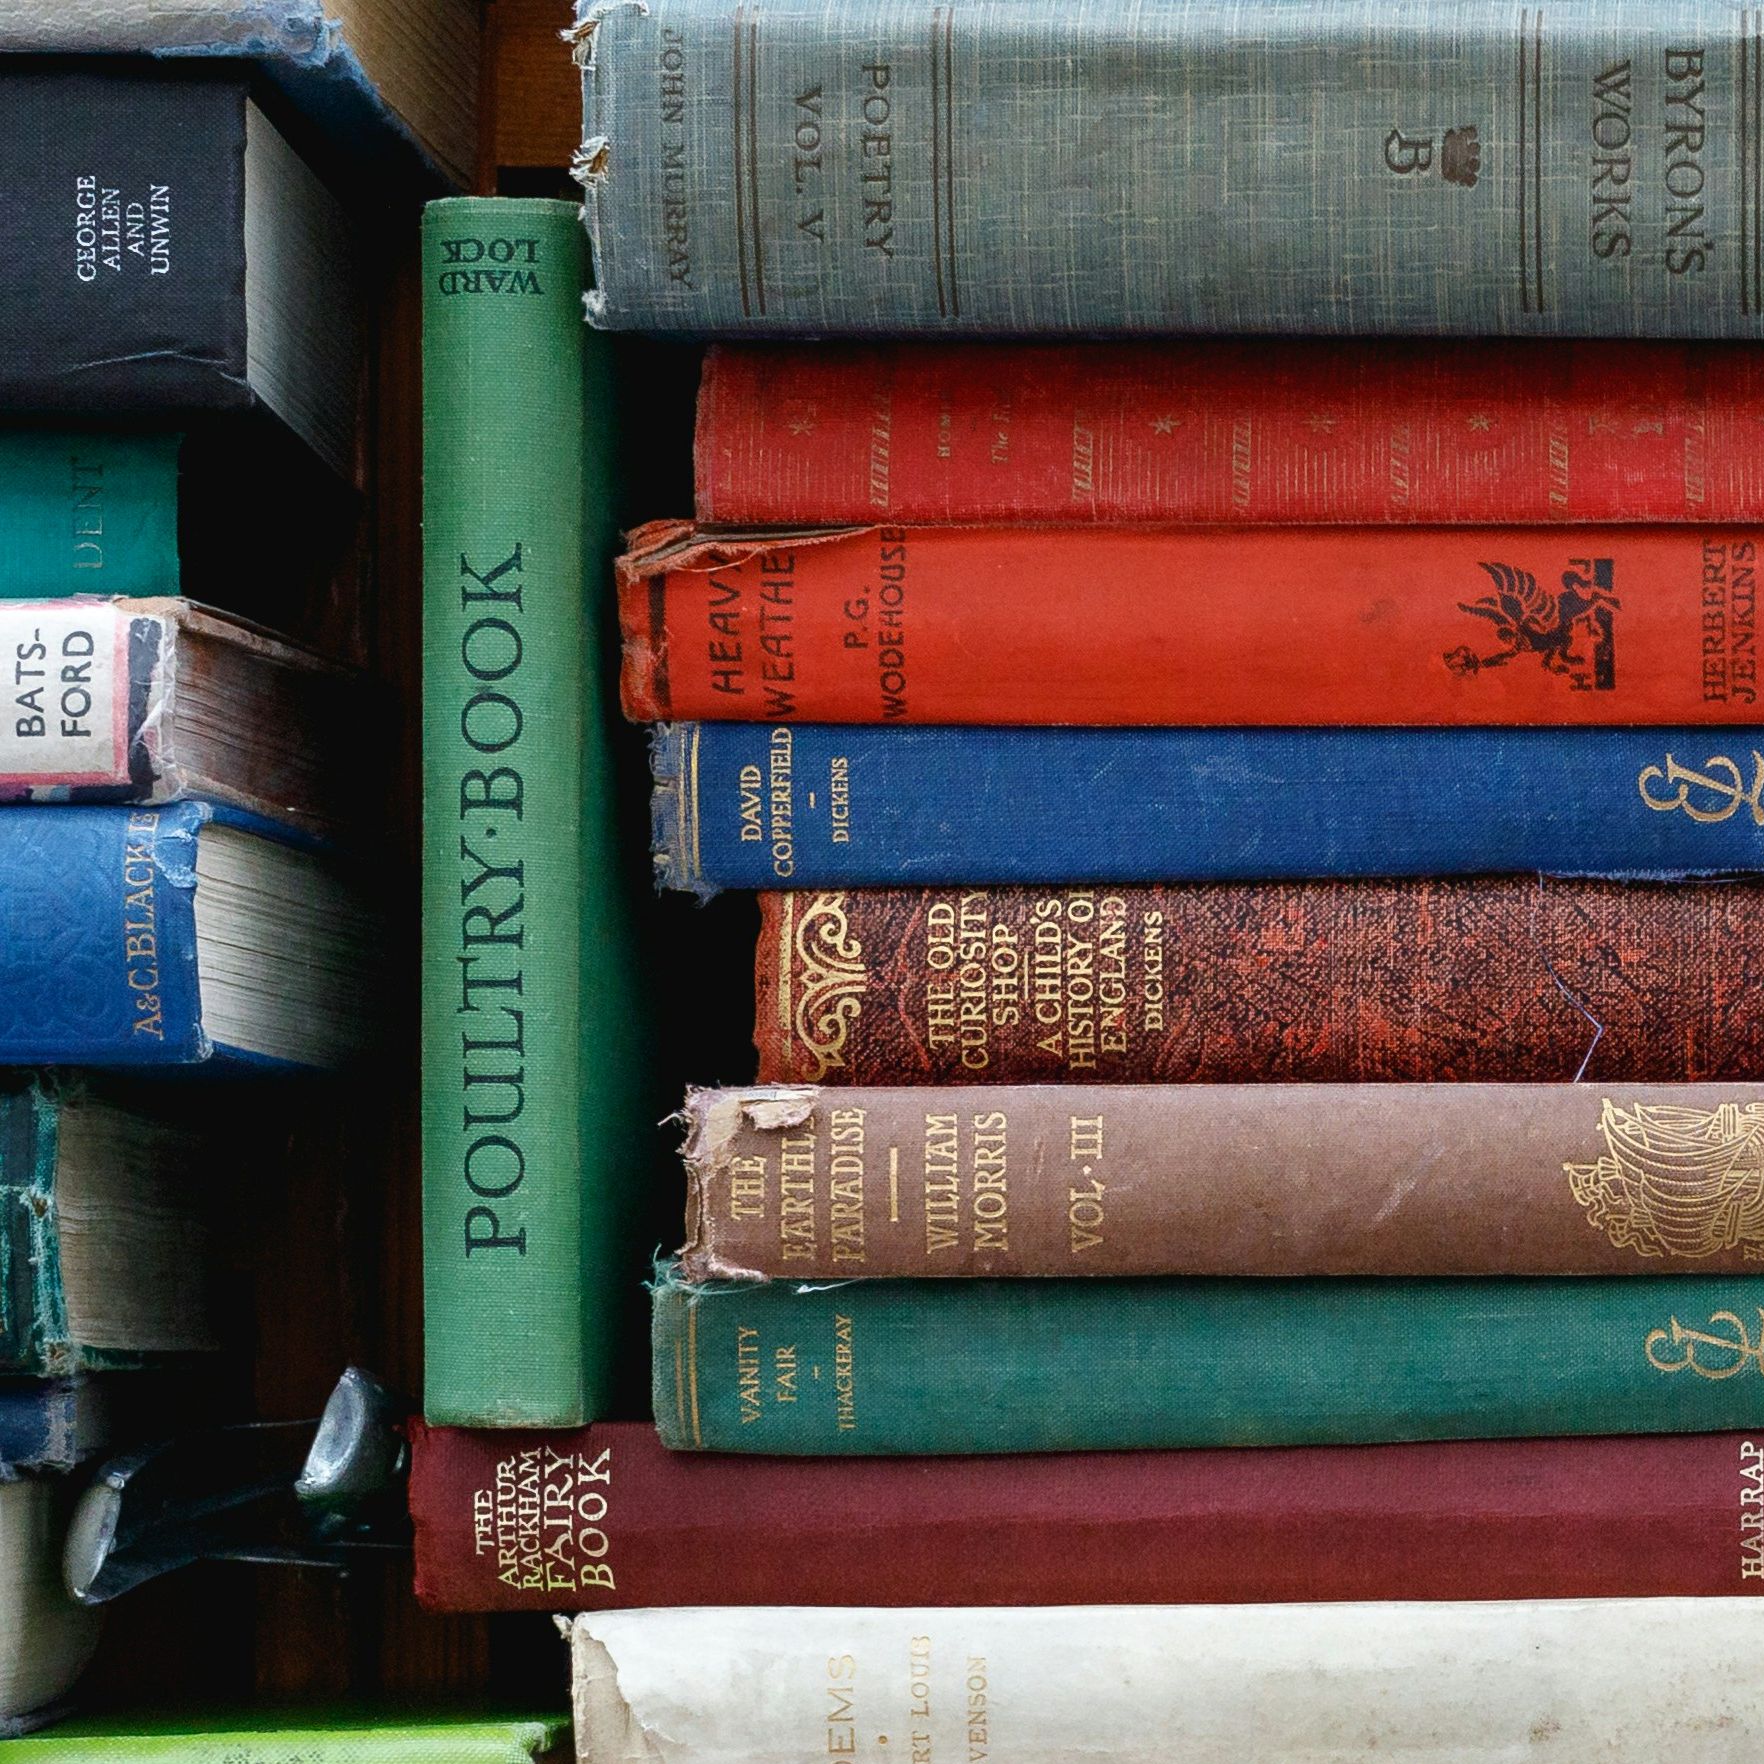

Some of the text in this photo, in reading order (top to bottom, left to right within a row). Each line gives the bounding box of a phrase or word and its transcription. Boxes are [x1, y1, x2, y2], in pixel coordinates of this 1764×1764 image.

[661, 28, 694, 290] JOHN MURRAY
[792, 83, 824, 195] VOL.
[861, 63, 893, 260] POETRY
[1592, 59, 1631, 259] WORKS
[76, 175, 97, 282] GEORGE
[101, 187, 121, 272] ALLEN
[126, 201, 145, 257] AND
[150, 184, 171, 275] UNWIN
[439, 269, 545, 295] WARD
[441, 238, 538, 263] LOCK
[61, 631, 94, 737] FORD
[1701, 537, 1728, 705] HERBERT
[1730, 539, 1757, 704] JENKINS
[740, 765, 762, 842] DAVID
[770, 728, 796, 878] COPPERFIELD
[832, 757, 849, 843] DICKENS
[928, 903, 955, 1048] THE OLD
[960, 892, 989, 1069] CURIOSITY
[992, 924, 1019, 1026] SHOP
[1032, 900, 1063, 1024] CHILD'S
[1069, 927, 1096, 1069] HISTORY
[1099, 895, 1128, 1053] ENGLAND
[1144, 910, 1163, 1031] DICKENS
[831, 1107, 867, 1263] PARADISE
[925, 1112, 959, 1254] WILLIAM
[974, 1111, 1008, 1252] MORRIS
[737, 1326, 762, 1424] VANITY
[776, 1345, 796, 1403] FAIR
[835, 1314, 856, 1432] THACKERAY
[474, 1490, 494, 1555] THE
[497, 1455, 520, 1589] ARTHUR
[518, 1449, 545, 1590] RACKHAM
[544, 1447, 577, 1593] FAIRY
[578, 1448, 616, 1591] BOOK
